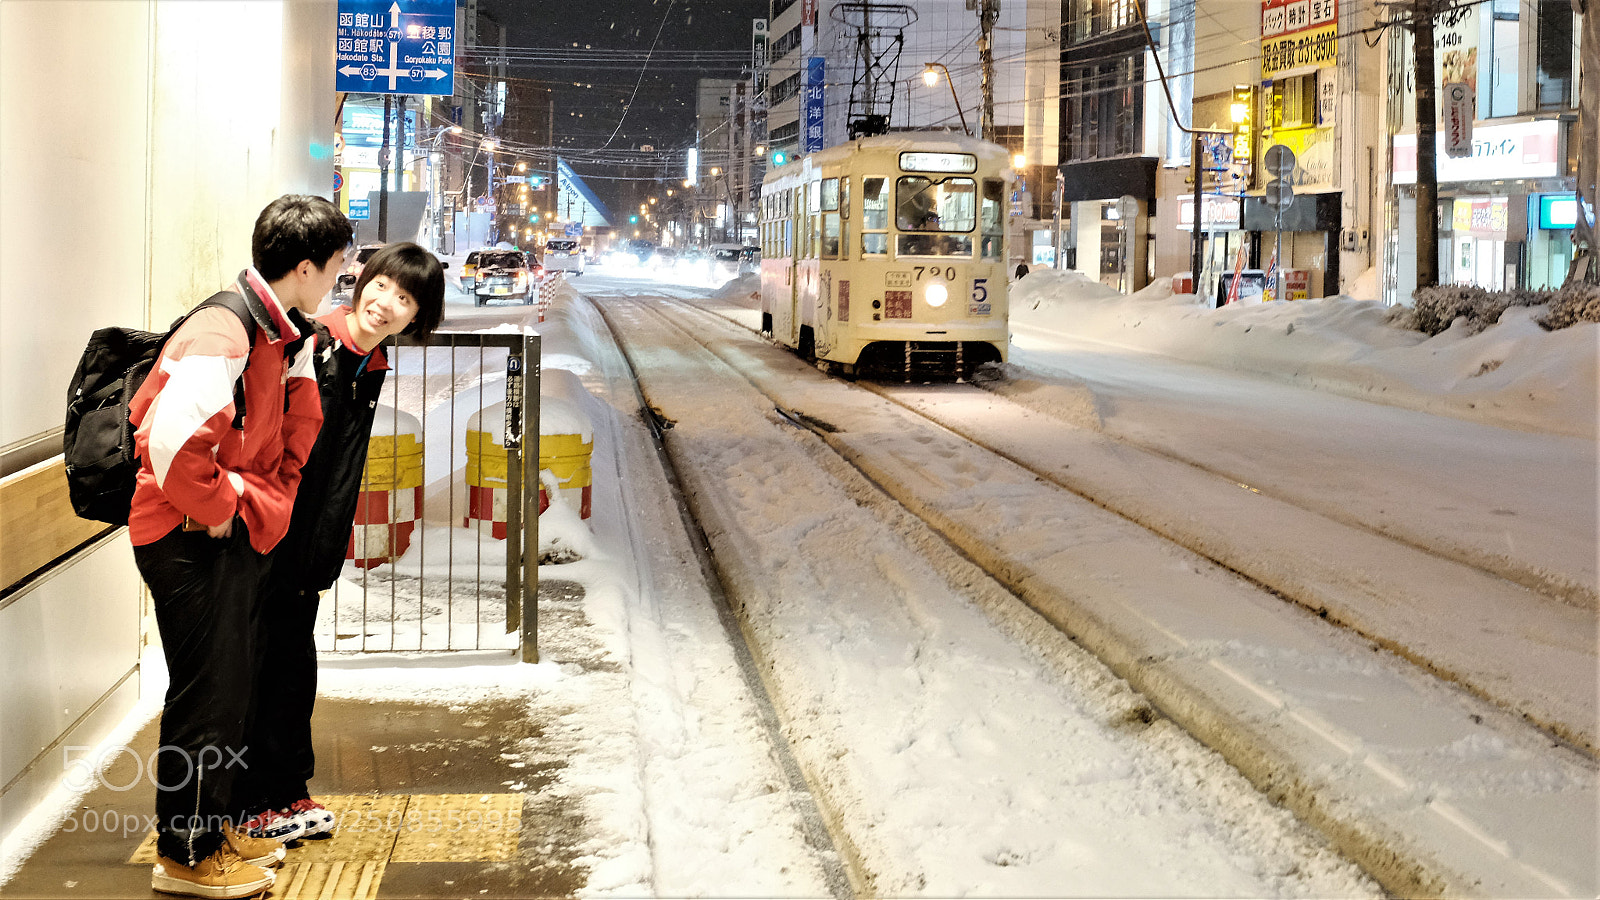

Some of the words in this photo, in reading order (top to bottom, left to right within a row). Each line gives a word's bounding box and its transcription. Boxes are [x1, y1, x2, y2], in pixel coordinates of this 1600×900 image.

[339, 12, 384, 28] 函館山
[1289, 5, 1305, 25] 時計
[1313, 1, 1331, 20] 宝石
[338, 28, 350, 37] Mt.
[388, 30, 401, 39] 571
[406, 25, 452, 40] 五稜郭
[338, 38, 384, 53] 函館駅
[421, 41, 451, 56] 公園
[337, 52, 369, 62] Hakodate
[371, 53, 385, 63] Sta.
[404, 55, 437, 65] Goryokaku
[438, 57, 452, 65] Park
[1263, 40, 1296, 72] 現金買取
[362, 68, 375, 77] 83
[411, 70, 424, 78] 571
[808, 86, 823, 153] 北洋銀行
[560, 178, 580, 199] Alpen
[972, 278, 988, 302] 5
